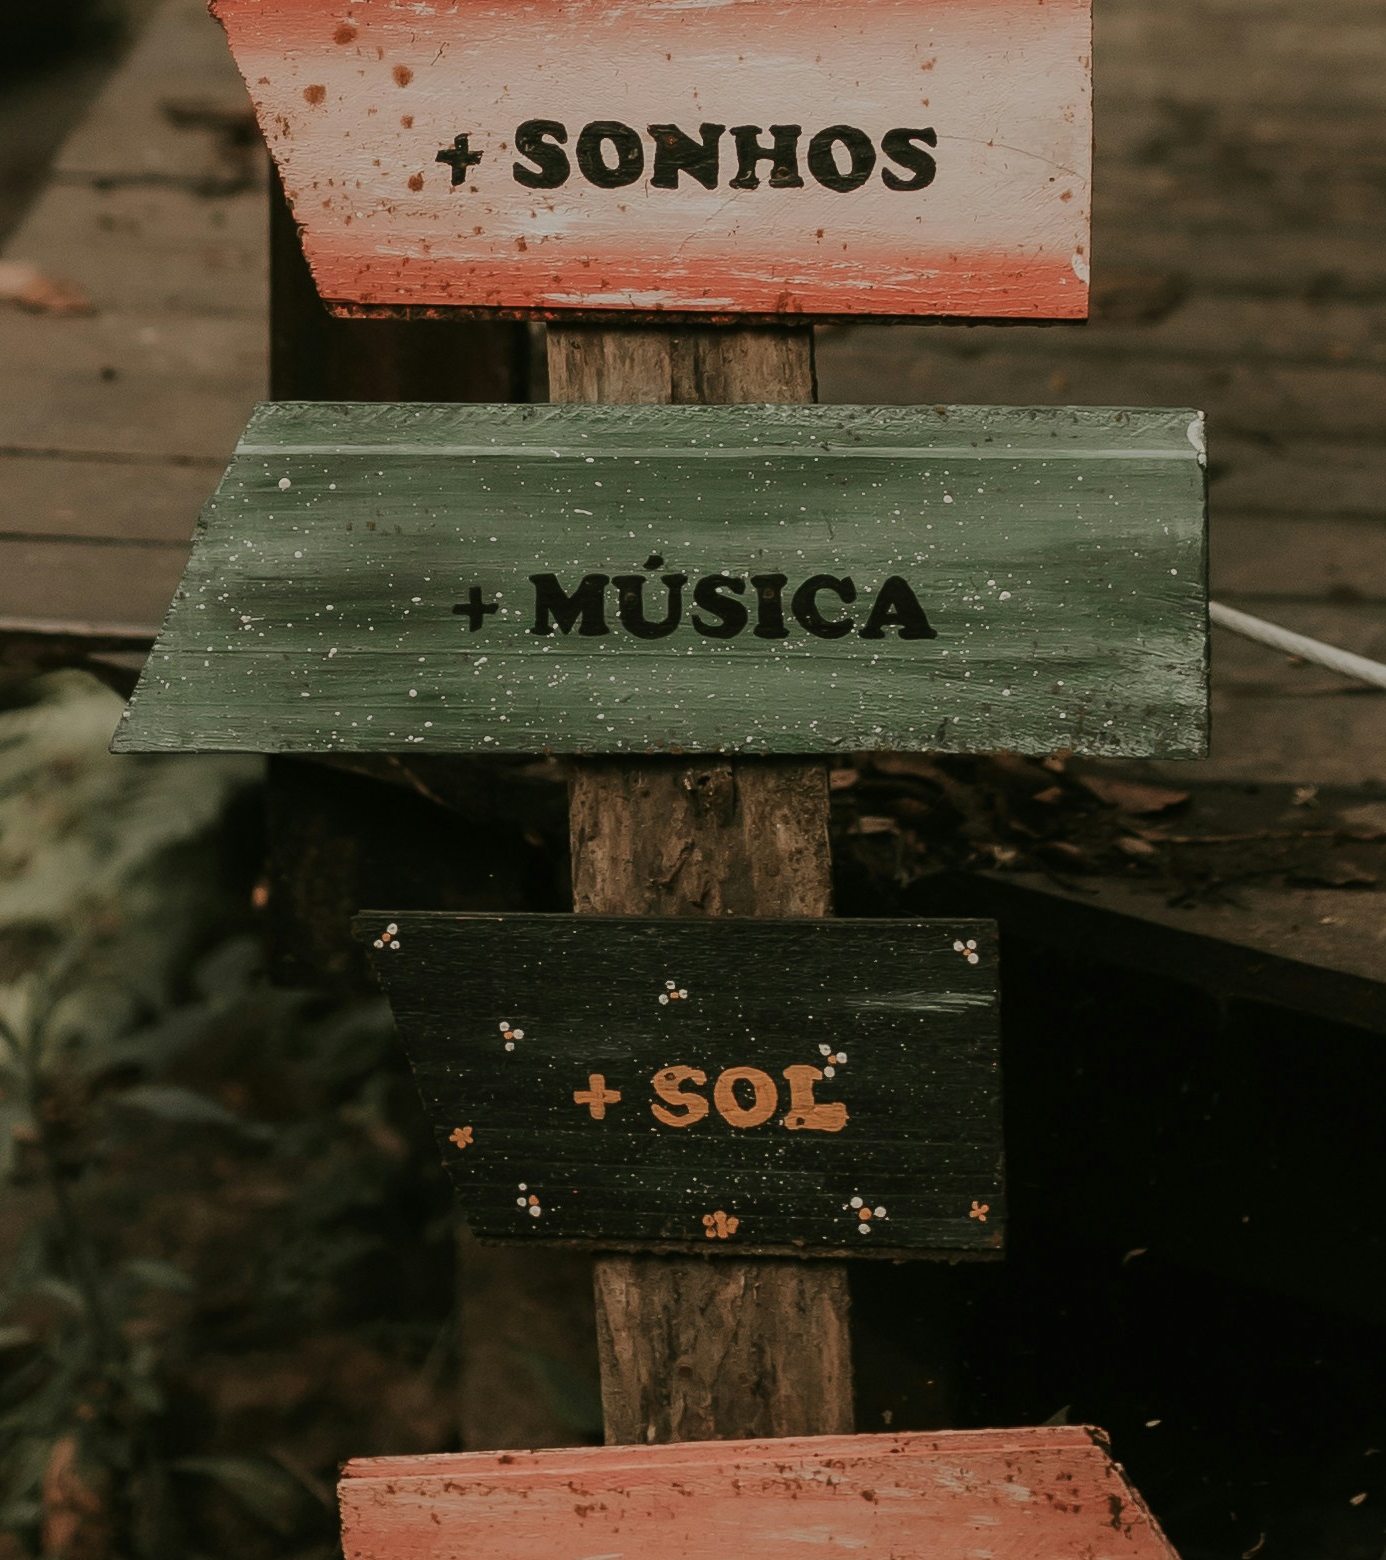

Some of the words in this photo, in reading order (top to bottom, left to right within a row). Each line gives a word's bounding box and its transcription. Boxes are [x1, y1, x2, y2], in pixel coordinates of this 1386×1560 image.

[436, 132, 483, 186] +
[512, 117, 938, 192] SONHOS
[452, 584, 499, 632] +
[529, 555, 937, 640] MÚSICA
[573, 1073, 621, 1119] +
[650, 1064, 849, 1132] SOL
